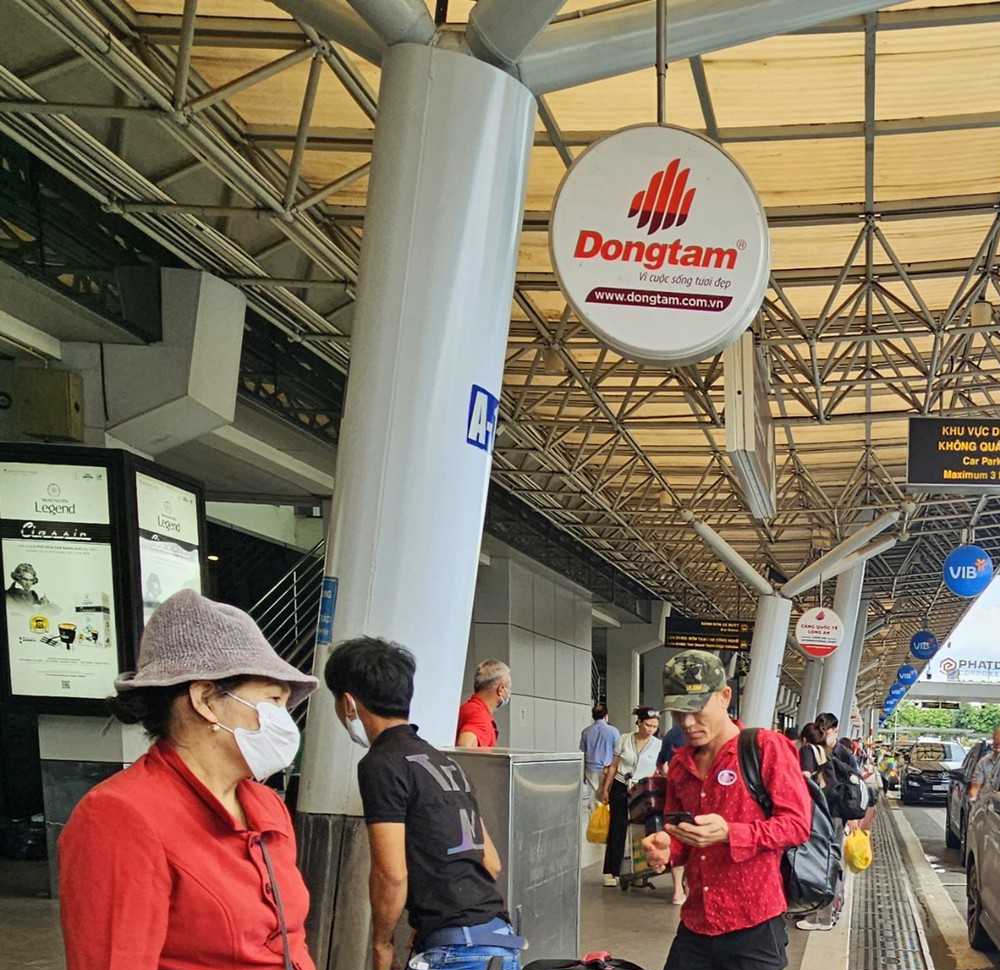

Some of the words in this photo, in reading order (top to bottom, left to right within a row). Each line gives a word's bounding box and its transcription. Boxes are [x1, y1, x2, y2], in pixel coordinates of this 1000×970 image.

[574, 230, 738, 270] Dongtam
[650, 274, 669, 284] cuộc
[672, 274, 693, 288] sống
[715, 279, 731, 290] đẹp
[595, 290, 724, 309] www.dongtam.com.vn
[942, 426, 965, 436] KHU
[938, 439, 977, 451] KHÔNG
[963, 456, 979, 465] Car
[943, 470, 988, 480] Maximum
[990, 471, 996, 480] 3
[35, 501, 76, 515] Legend
[157, 514, 181, 532] Legend
[949, 566, 977, 580] VIB
[913, 641, 930, 650] VIB
